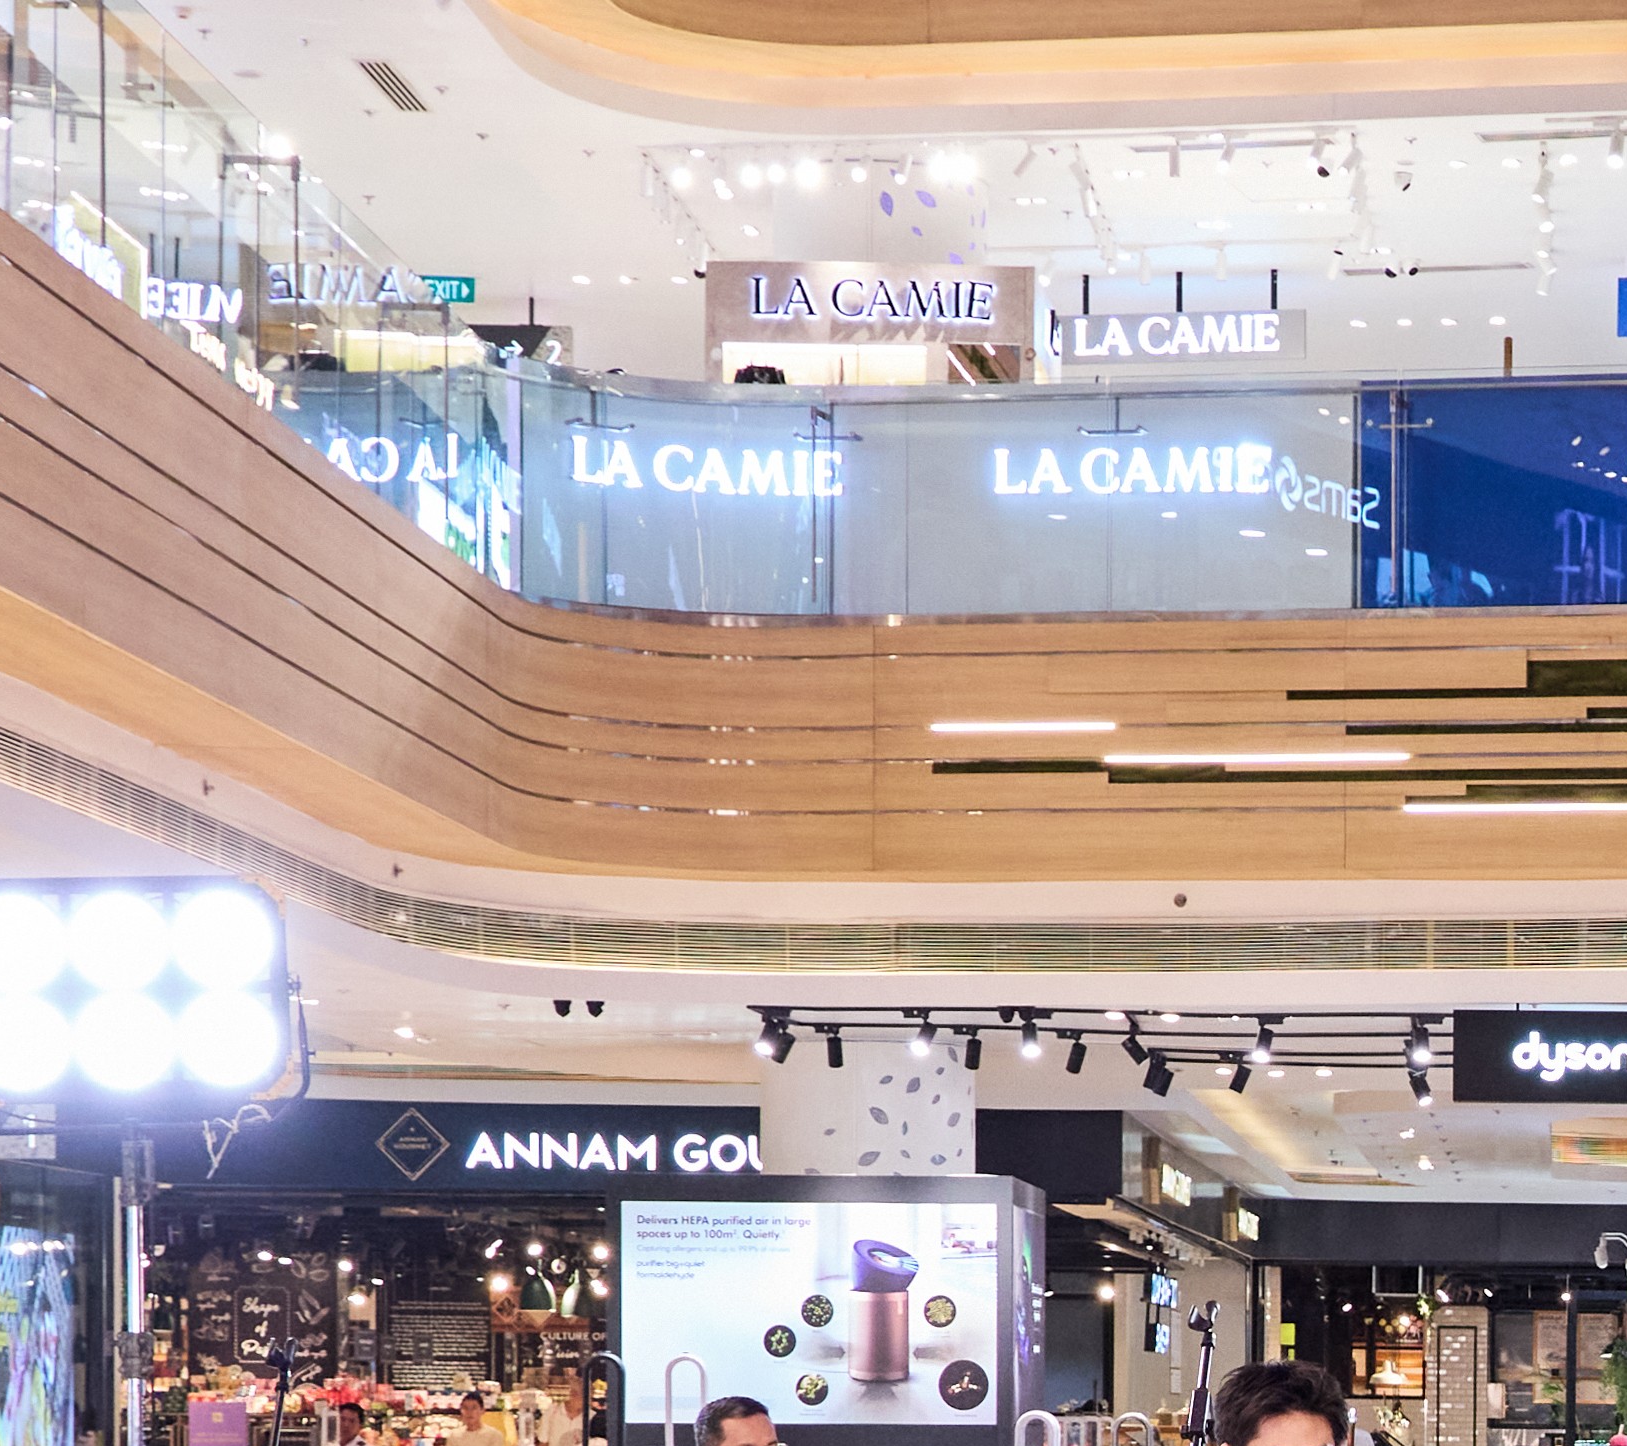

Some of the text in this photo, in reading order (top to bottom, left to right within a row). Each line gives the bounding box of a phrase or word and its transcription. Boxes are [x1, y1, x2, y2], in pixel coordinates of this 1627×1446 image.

[751, 277, 994, 321] LA CAMIE
[1074, 313, 1280, 358] LA CAMIE
[572, 434, 843, 497] LA CAMIE
[994, 447, 1272, 495] LA CAMIE
[465, 1131, 657, 1171] ANNAM
[637, 1215, 811, 1227] Delivers HEPA purified air in large
[637, 1230, 671, 1240] spaces
[674, 1230, 687, 1240] up
[690, 1229, 700, 1239] to
[539, 1331, 589, 1342] CULTURE
